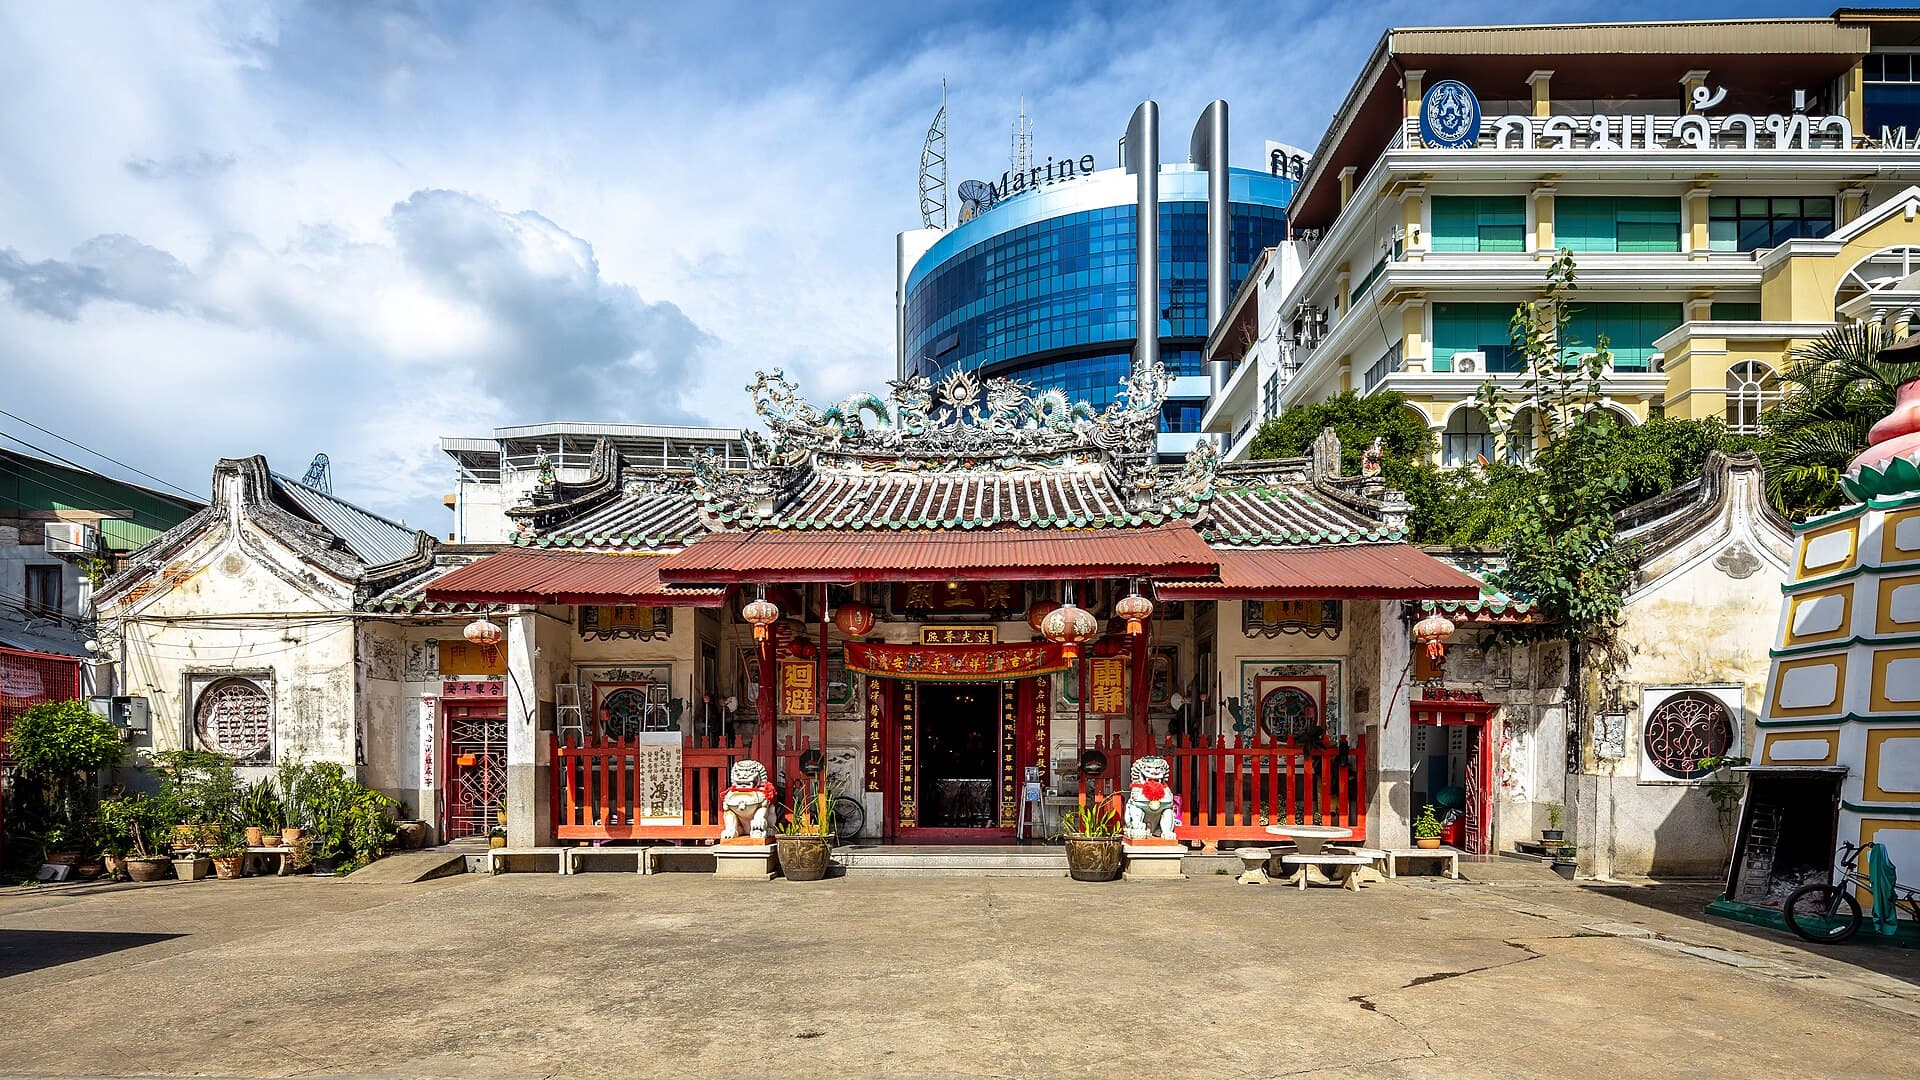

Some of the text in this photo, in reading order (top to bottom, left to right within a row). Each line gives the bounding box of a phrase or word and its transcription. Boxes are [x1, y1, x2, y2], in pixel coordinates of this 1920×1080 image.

[1493, 86, 1852, 150] กรมเจ้าท่า
[988, 154, 1094, 206] Marine
[1271, 149, 1311, 180] กร
